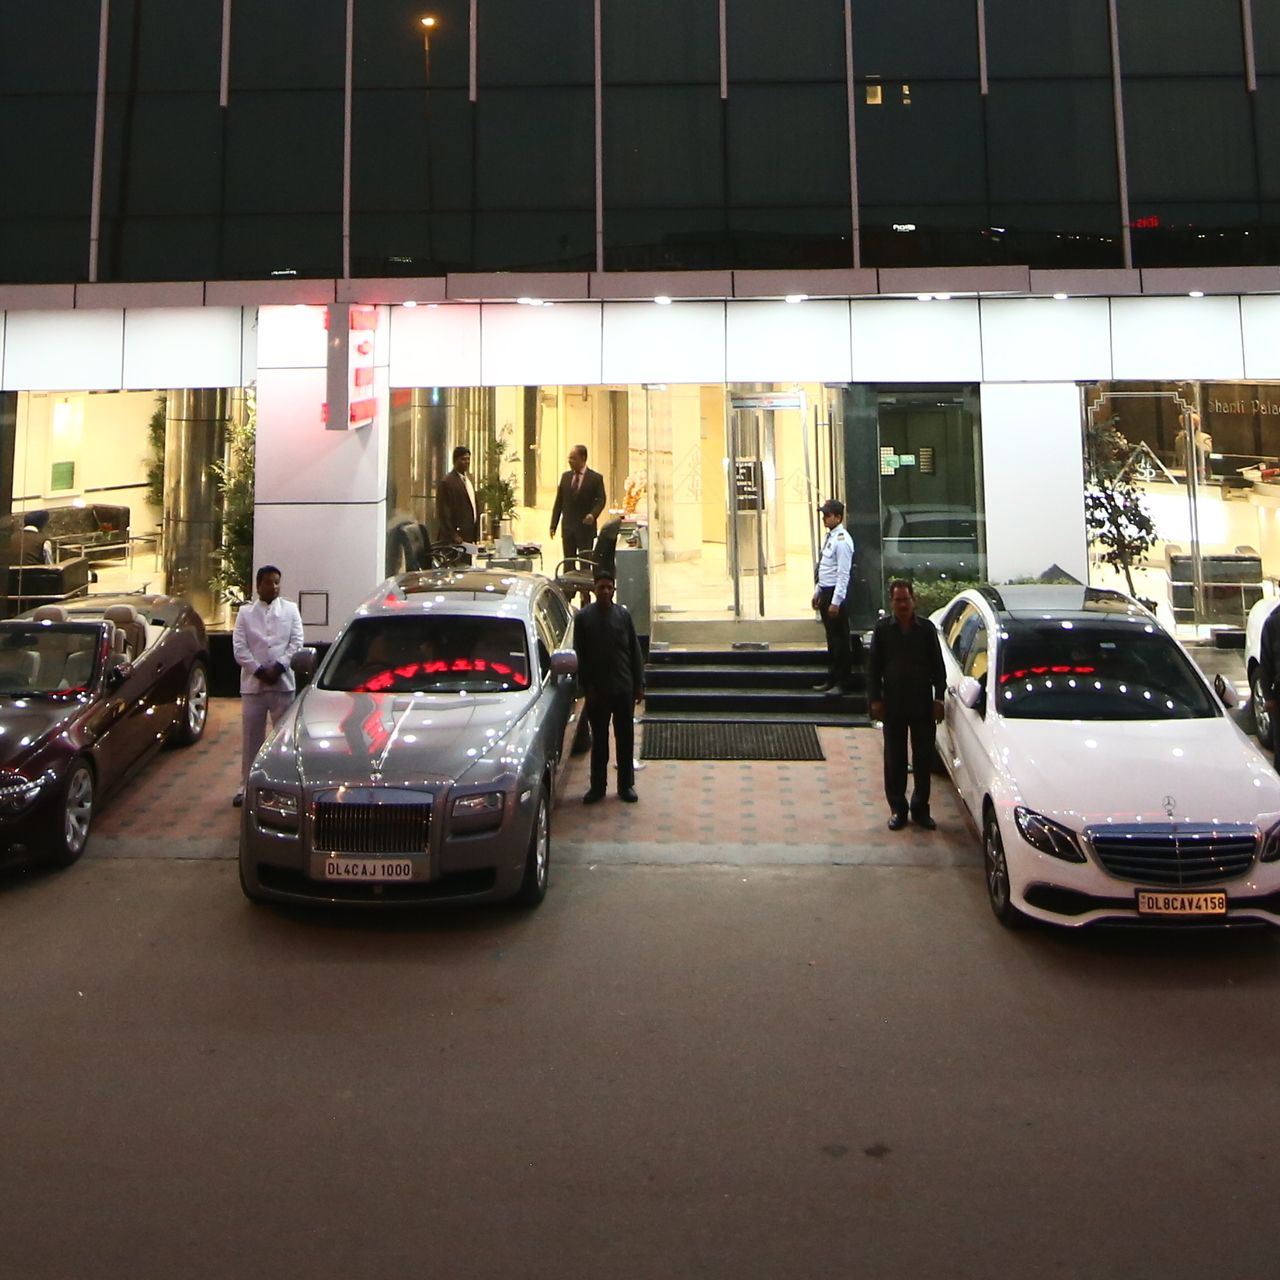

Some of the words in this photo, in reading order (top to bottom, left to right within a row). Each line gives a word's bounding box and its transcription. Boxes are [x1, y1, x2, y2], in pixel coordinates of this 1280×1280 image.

[1208, 400, 1245, 414] Shanti
[381, 864, 410, 876] 1000
[1147, 896, 1224, 911] DL8CAV4158
